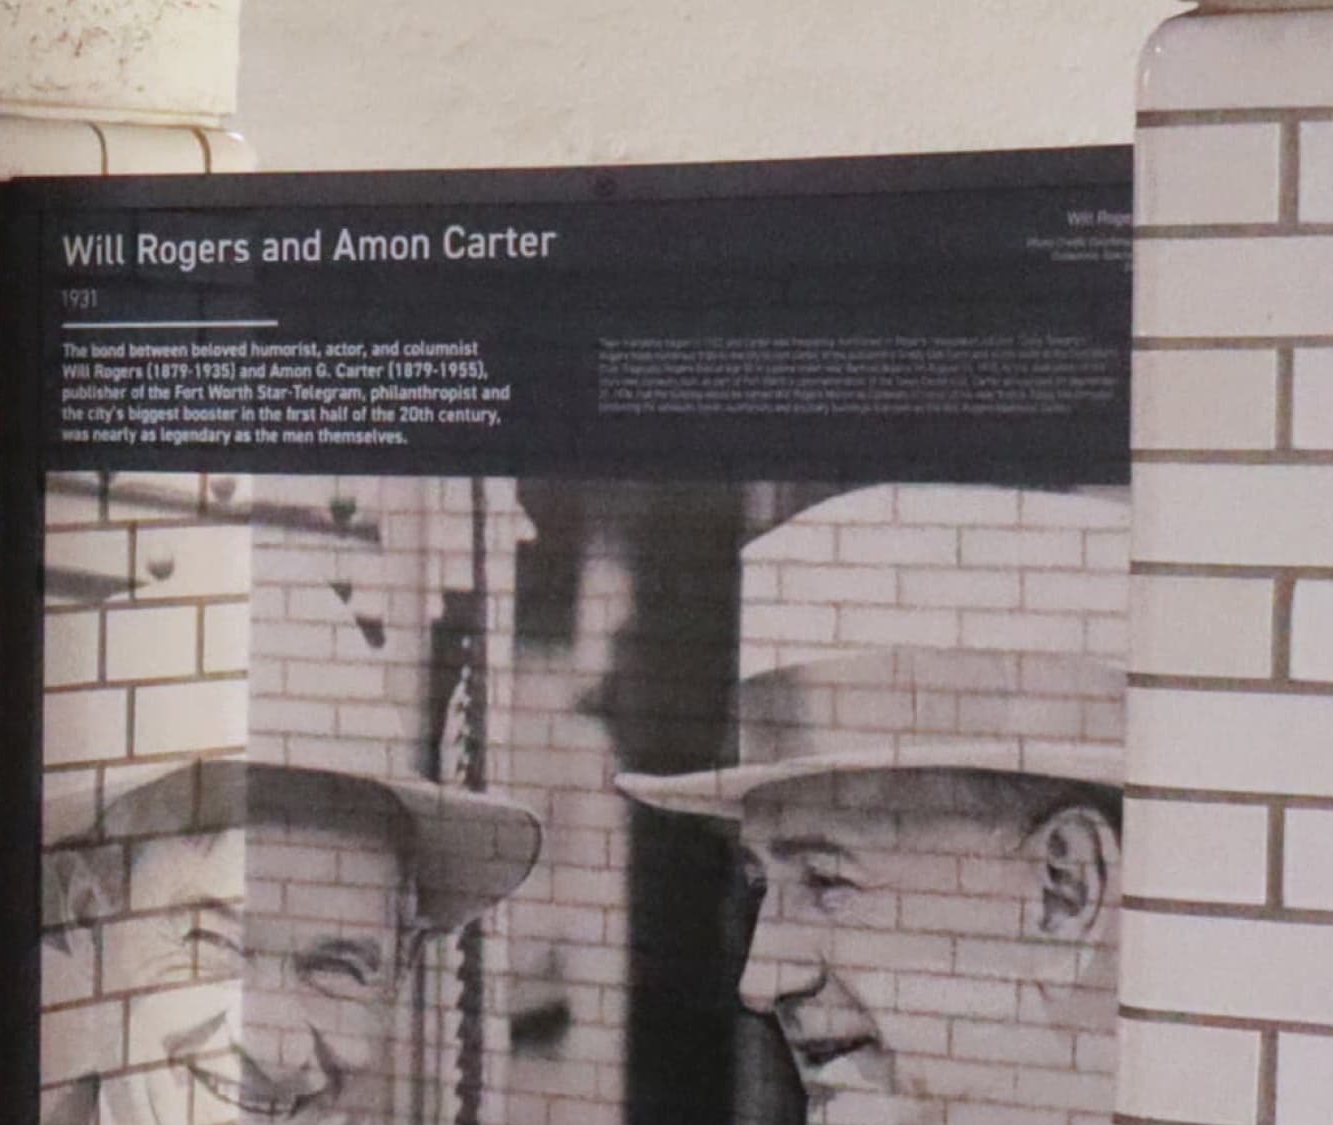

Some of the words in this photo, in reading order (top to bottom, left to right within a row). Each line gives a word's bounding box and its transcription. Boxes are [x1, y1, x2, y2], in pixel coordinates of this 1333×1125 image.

[62, 235, 125, 265] Will
[137, 233, 250, 271] Rogers
[261, 229, 321, 262] and
[333, 228, 430, 261] Amon
[442, 225, 557, 259] Carter
[61, 289, 98, 309] 1931
[63, 343, 88, 357] The
[91, 343, 125, 358] bond
[129, 342, 187, 357] between
[191, 342, 247, 357] beloved
[251, 341, 322, 358] humorist,
[326, 344, 367, 358] actor,
[372, 341, 399, 356] and
[403, 341, 478, 356] columnist
[62, 363, 90, 378] Will
[94, 364, 143, 381] Rogers
[146, 363, 236, 379] (1879-1935)
[240, 364, 266, 378] and
[269, 364, 312, 378] Amon
[316, 363, 331, 378] G.
[336, 363, 383, 378] Carter
[388, 361, 488, 379] (1879-1955),
[62, 386, 126, 401] publisher
[130, 386, 145, 399] of
[148, 386, 171, 399] the
[175, 385, 204, 399] Fort
[208, 385, 253, 399] Worth
[257, 384, 366, 402] Star-Telegram,
[370, 384, 478, 402] philanthropist
[482, 384, 511, 399] and
[62, 405, 84, 420] the
[88, 405, 124, 423] city's
[128, 406, 179, 423] biggest
[182, 406, 237, 420] booster
[241, 406, 256, 420] in
[259, 406, 282, 420] the
[286, 406, 316, 421] first
[320, 406, 348, 421] half
[352, 406, 367, 421] of
[371, 407, 395, 421] the
[399, 406, 434, 422] 20th
[438, 408, 502, 426] century,
[62, 429, 89, 441] was
[93, 427, 136, 443] nearly
[141, 430, 156, 441] as
[161, 427, 231, 445] legendary
[235, 430, 251, 442] as
[255, 427, 278, 442] the
[283, 430, 314, 442] men
[318, 428, 408, 444] themselves.
